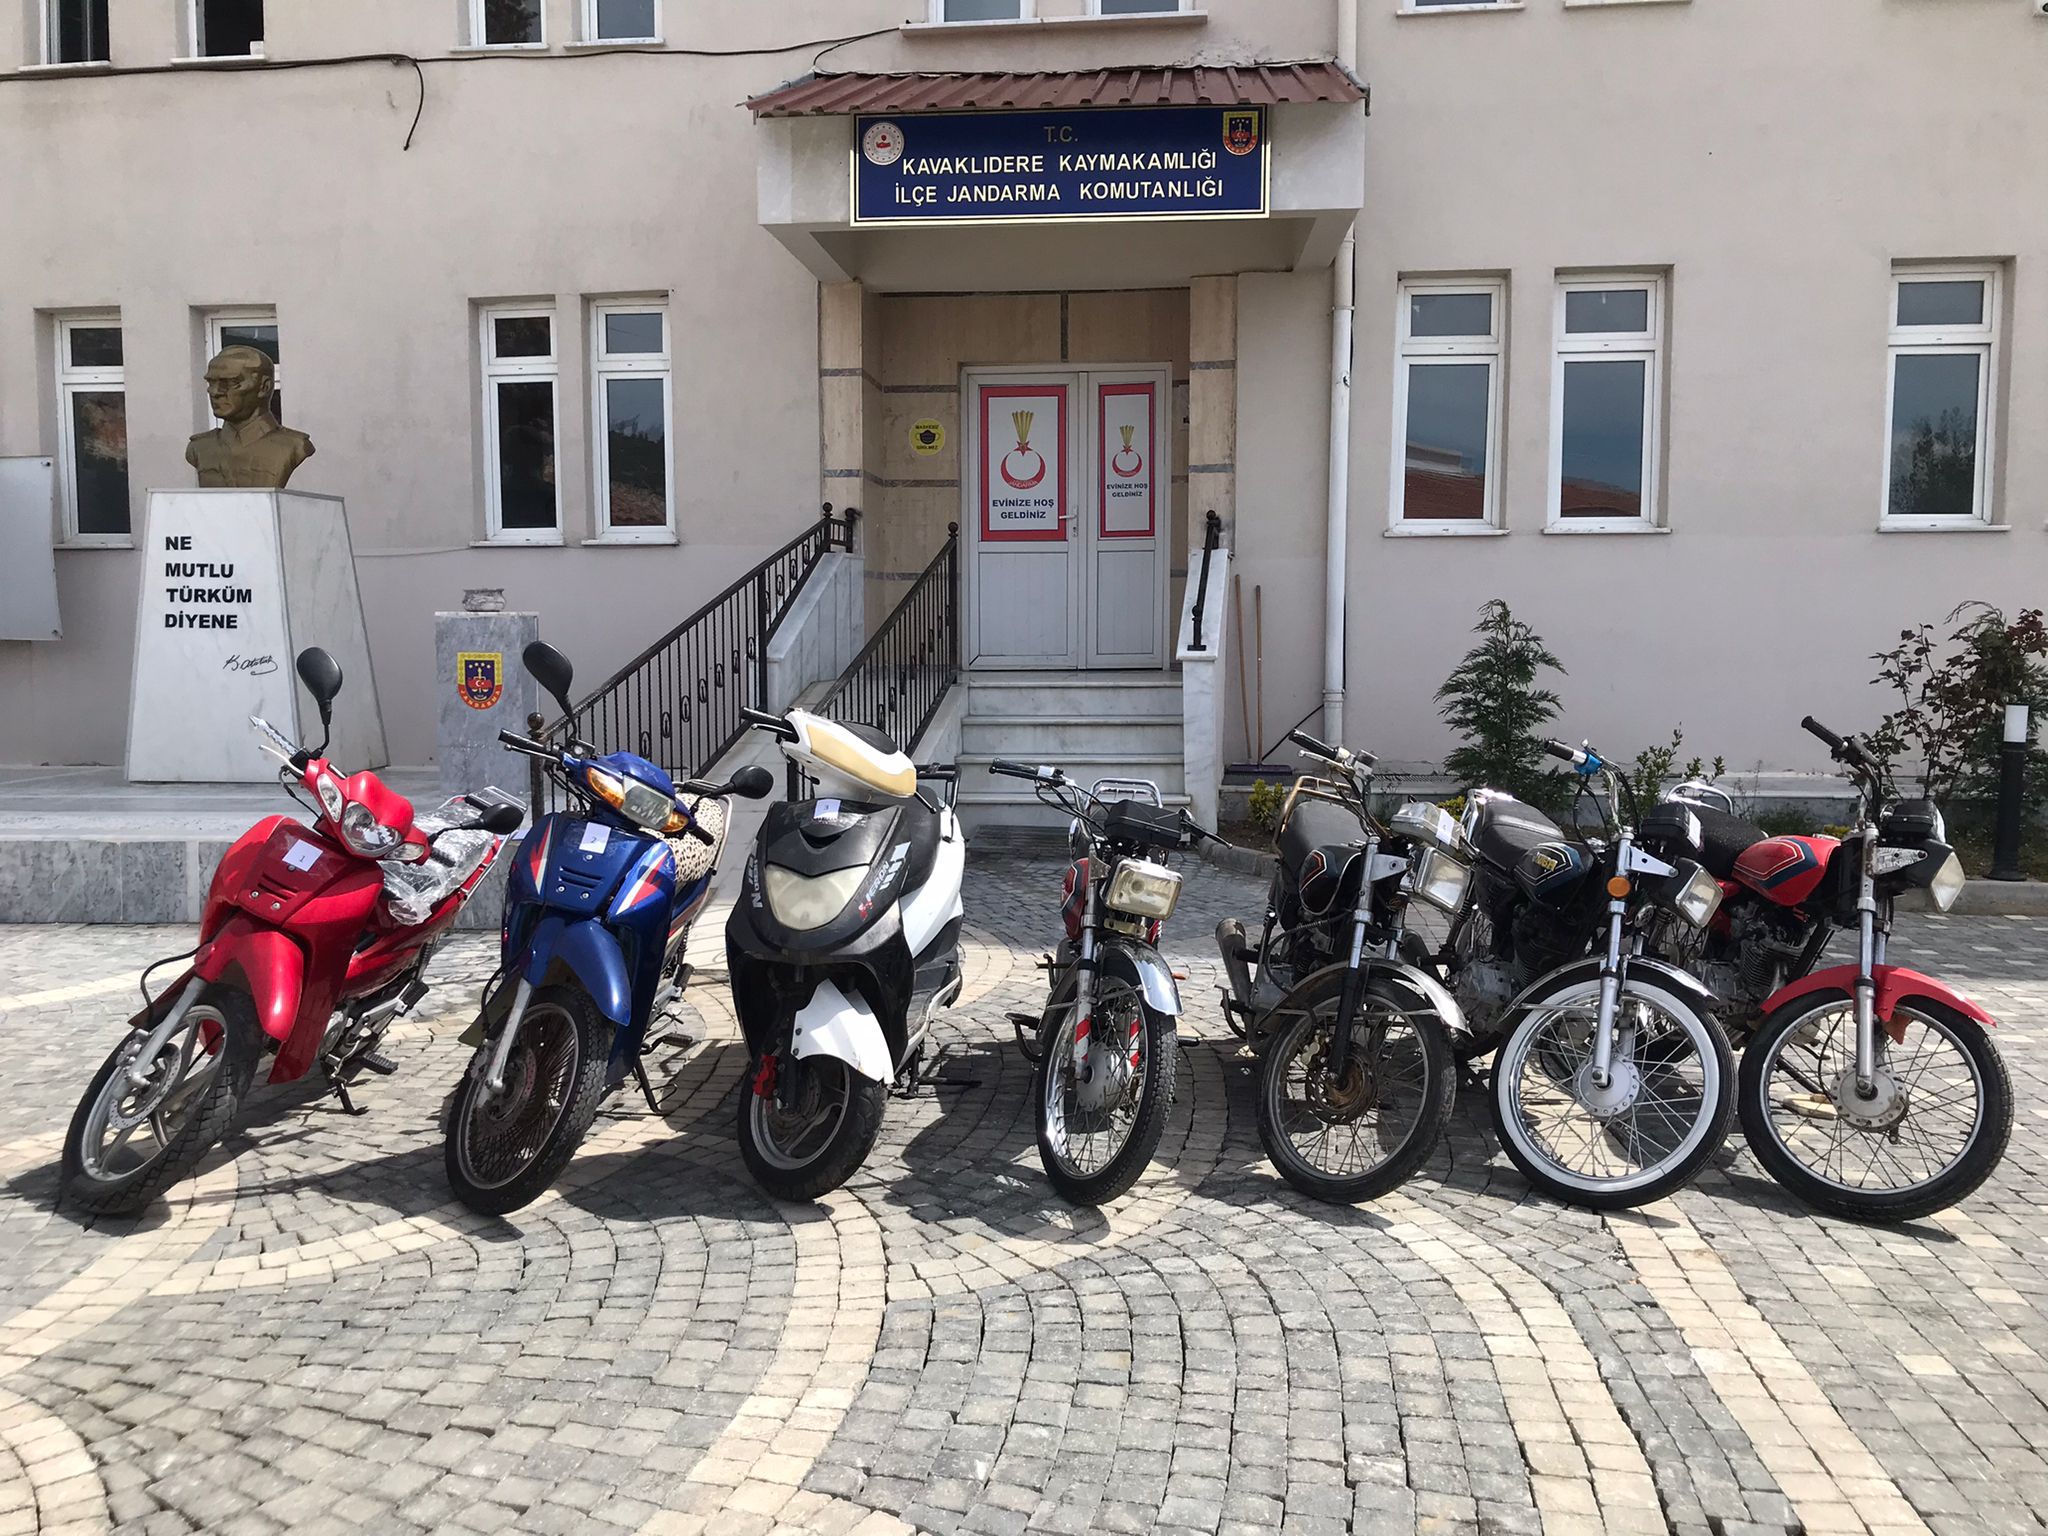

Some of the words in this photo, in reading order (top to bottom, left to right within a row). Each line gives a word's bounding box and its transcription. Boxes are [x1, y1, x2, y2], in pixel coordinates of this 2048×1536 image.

[1043, 126, 1079, 143] T.C.
[902, 155, 1044, 175] KAVAKLIDERE
[1059, 148, 1216, 171] KAYMAKAMLIĞI
[895, 182, 937, 206] İLÇE
[947, 184, 1061, 203] JANDARMA
[1080, 176, 1223, 200] KOMUTANLIĞI
[992, 499, 1031, 507] EVİNİZE
[1034, 499, 1055, 508] HOŞ
[1000, 510, 1046, 519] GELDİNİZ
[165, 536, 192, 550] NE
[165, 563, 234, 577] MUTLU
[166, 586, 252, 603] TÜRKÜM
[165, 610, 238, 629] DİYENE
